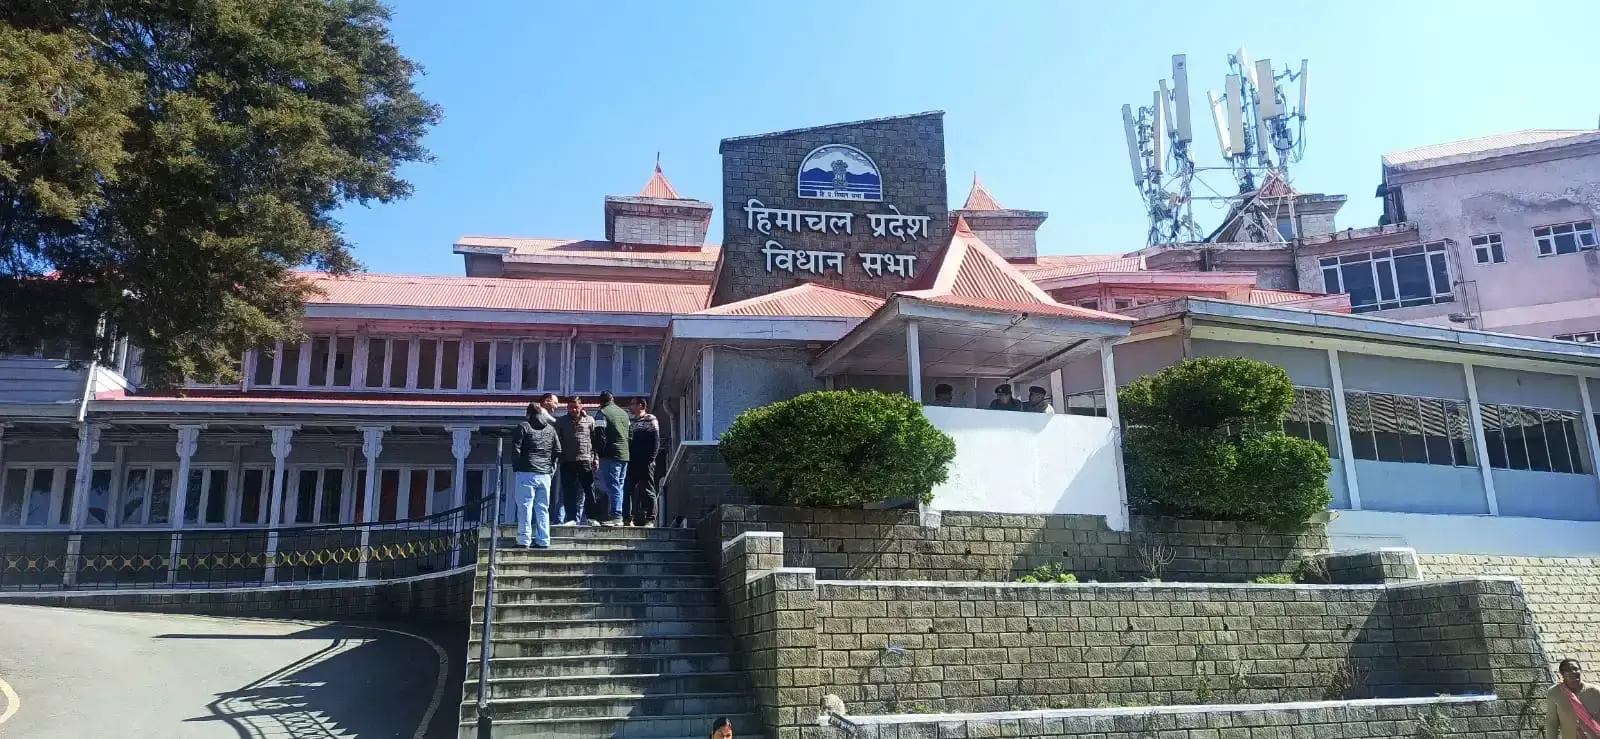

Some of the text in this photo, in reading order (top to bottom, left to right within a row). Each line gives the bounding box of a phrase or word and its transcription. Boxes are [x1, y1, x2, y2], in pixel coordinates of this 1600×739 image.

[744, 198, 931, 242] हिमाचल प्रदेश
[761, 240, 917, 279] विधान सभा
